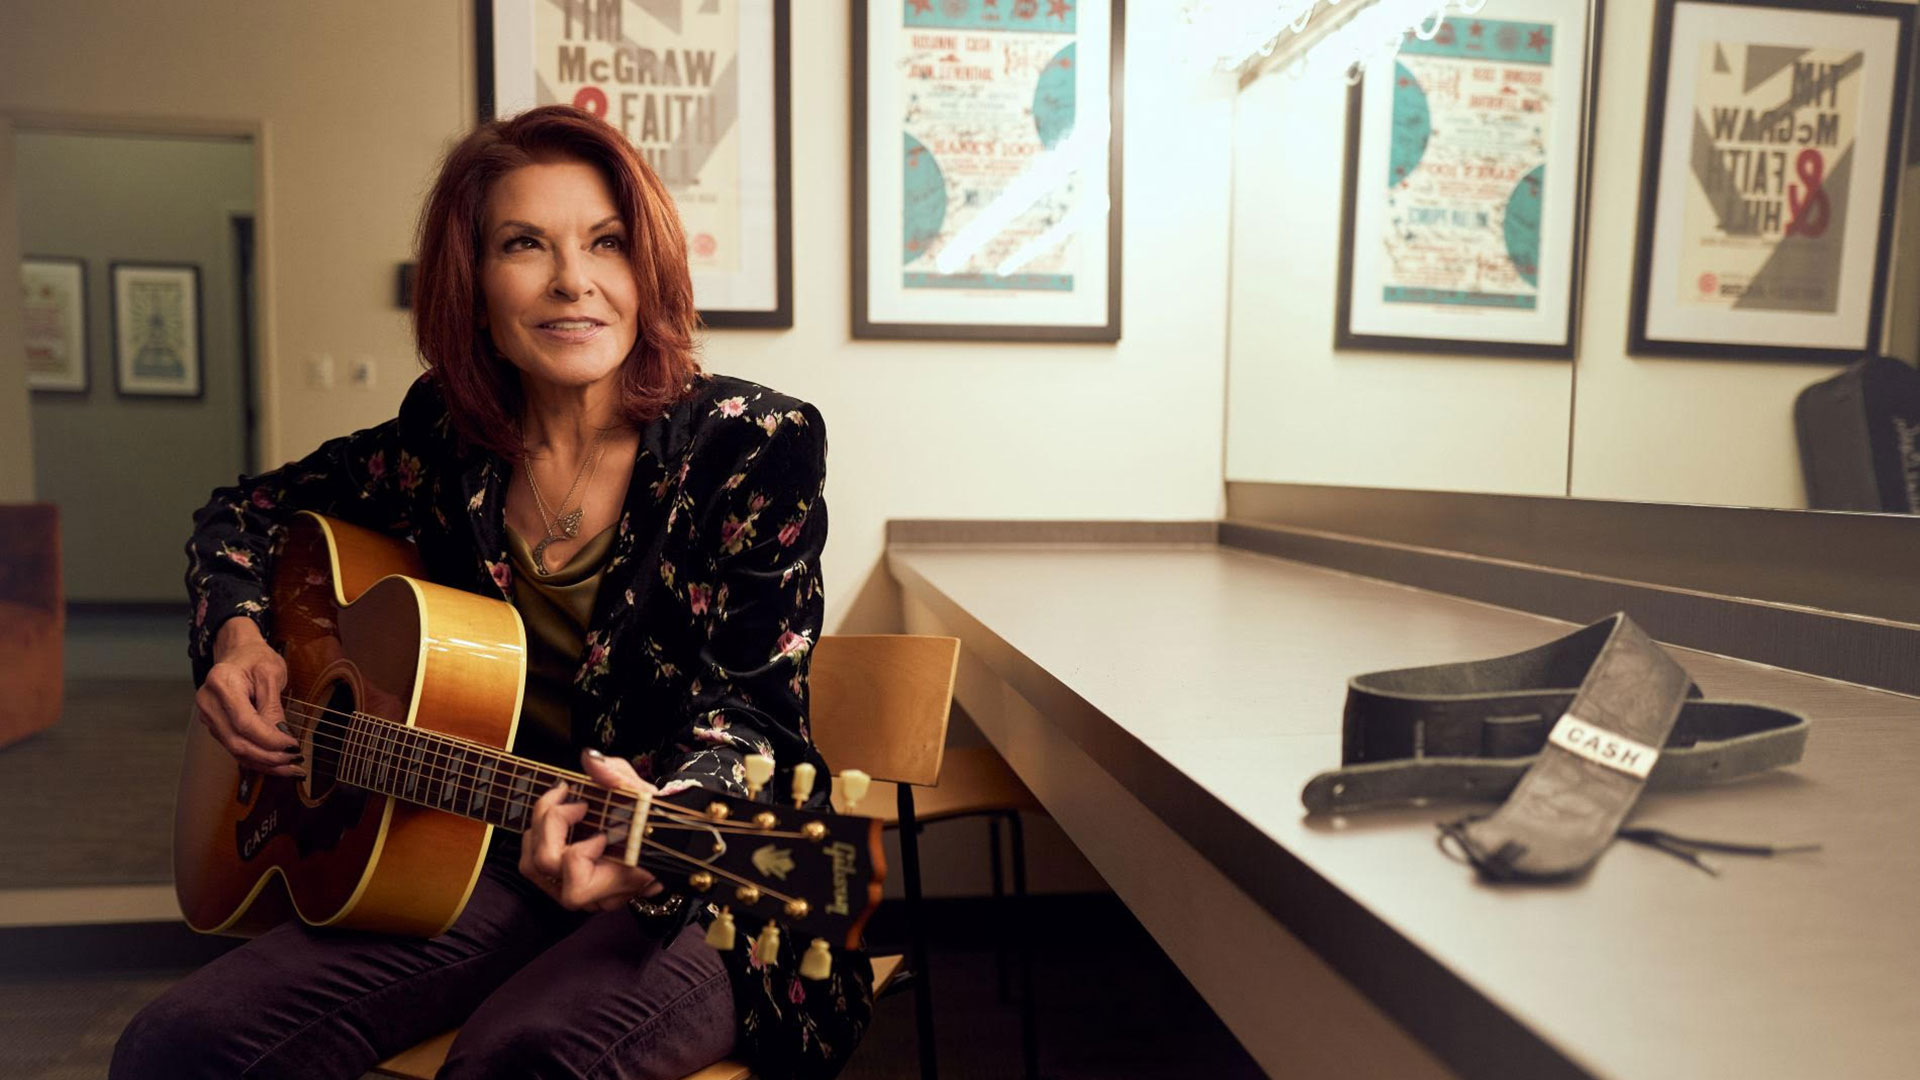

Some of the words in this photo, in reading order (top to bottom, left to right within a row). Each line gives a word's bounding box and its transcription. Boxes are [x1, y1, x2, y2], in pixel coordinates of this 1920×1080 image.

[557, 45, 716, 87] McGRAW
[621, 93, 717, 144] FAITH
[1566, 727, 1641, 767] CASH
[243, 808, 279, 858] CASH
